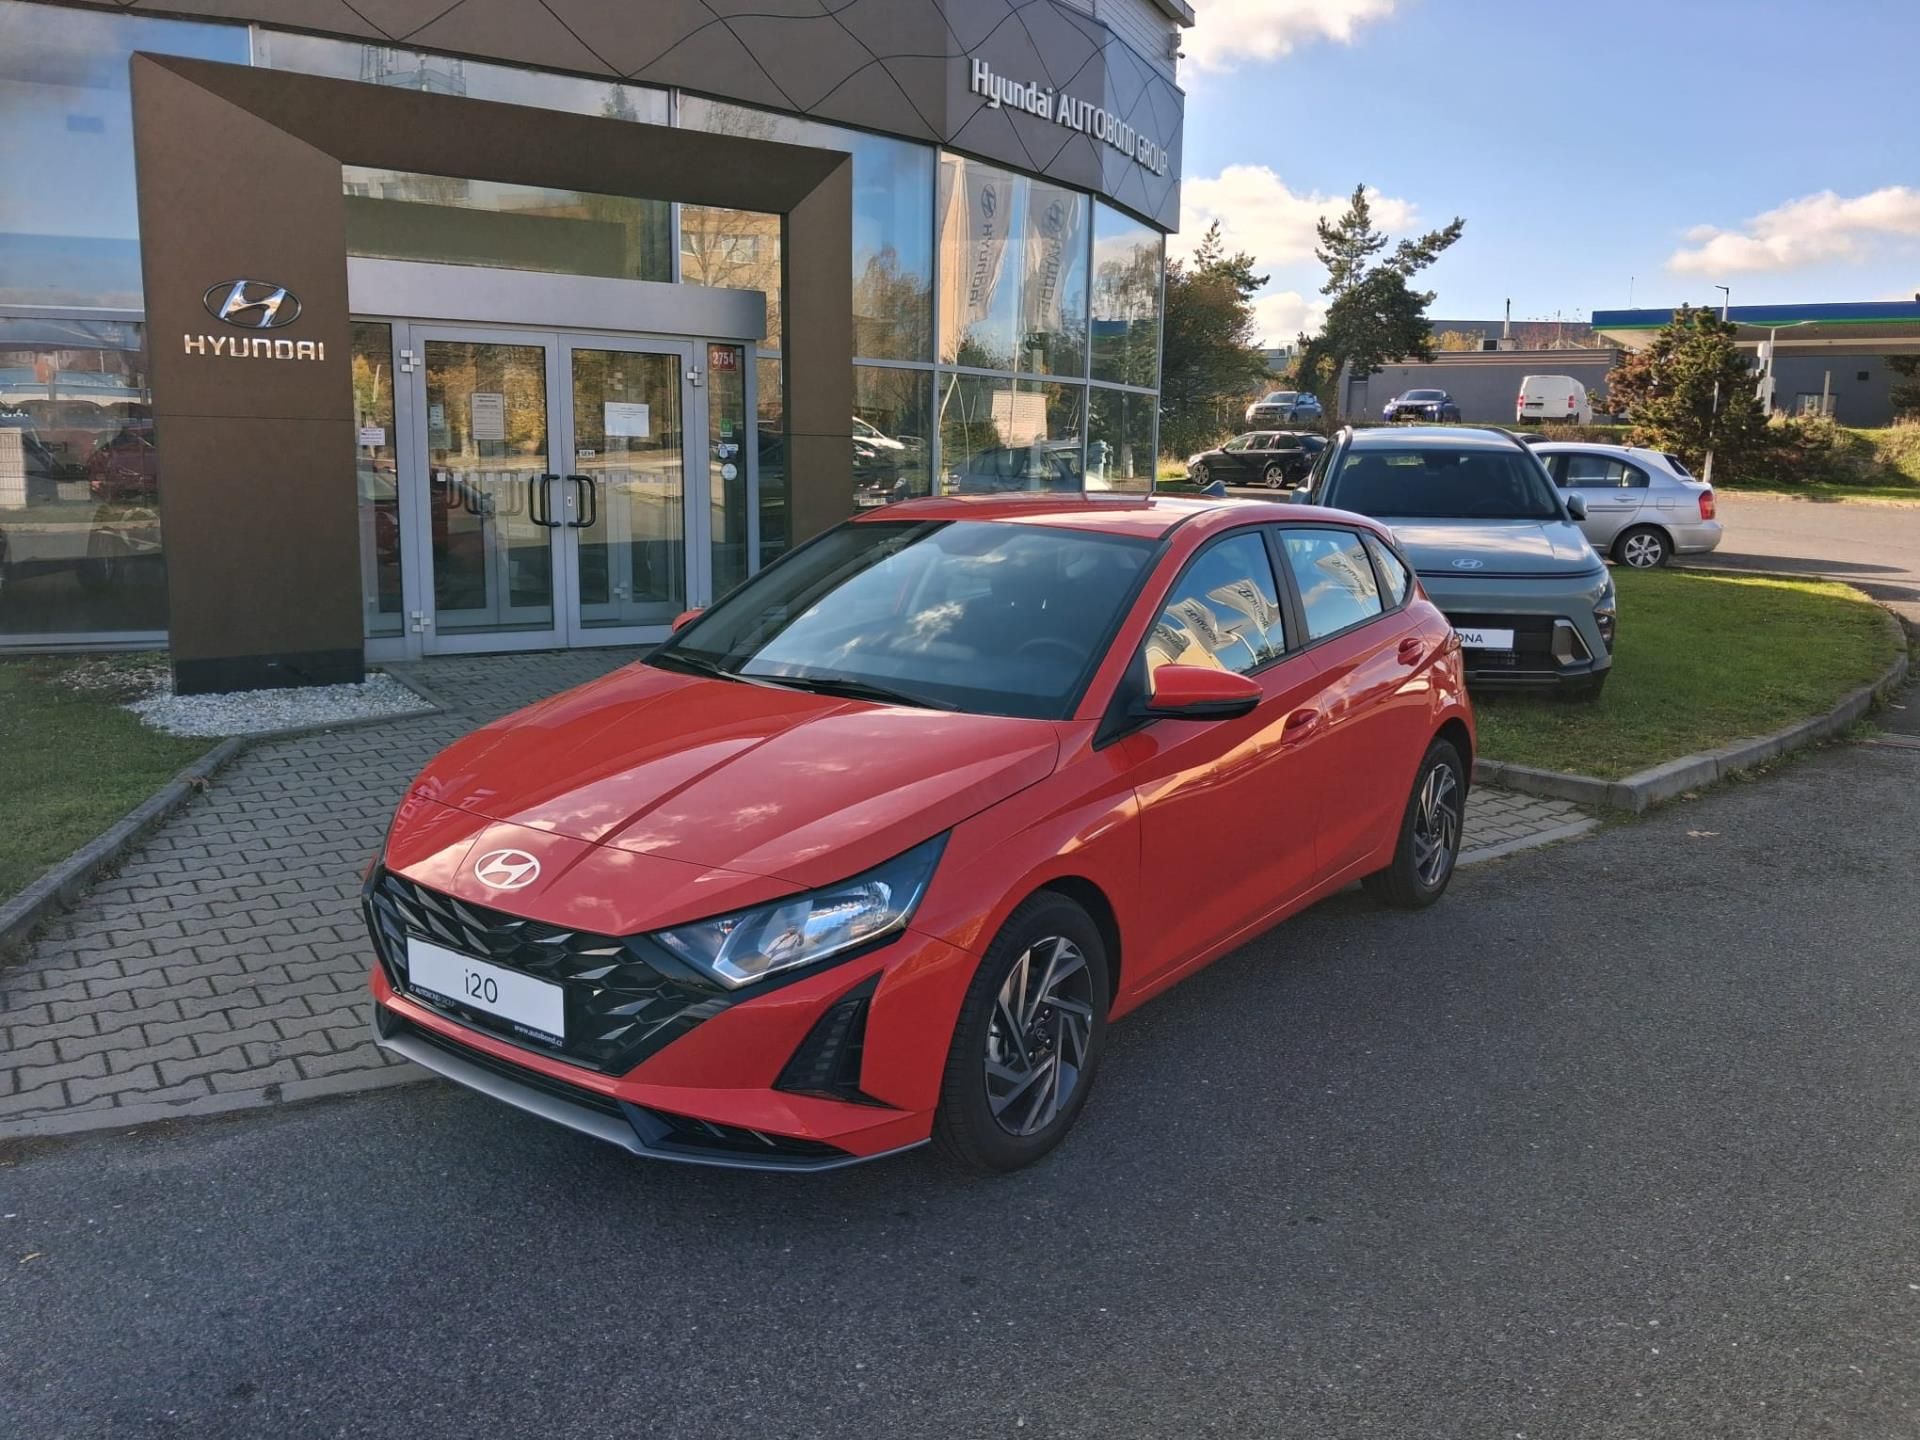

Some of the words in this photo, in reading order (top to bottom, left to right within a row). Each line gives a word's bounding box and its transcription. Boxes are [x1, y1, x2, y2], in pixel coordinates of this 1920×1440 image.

[971, 58, 1053, 119] Hyundai
[1056, 94, 1136, 158] AUTOBOND
[1137, 135, 1169, 177] GROUP
[184, 333, 325, 361] HYUNDAI
[712, 351, 734, 365] 2754
[1457, 633, 1484, 643] ONA
[465, 968, 498, 1004] i20
